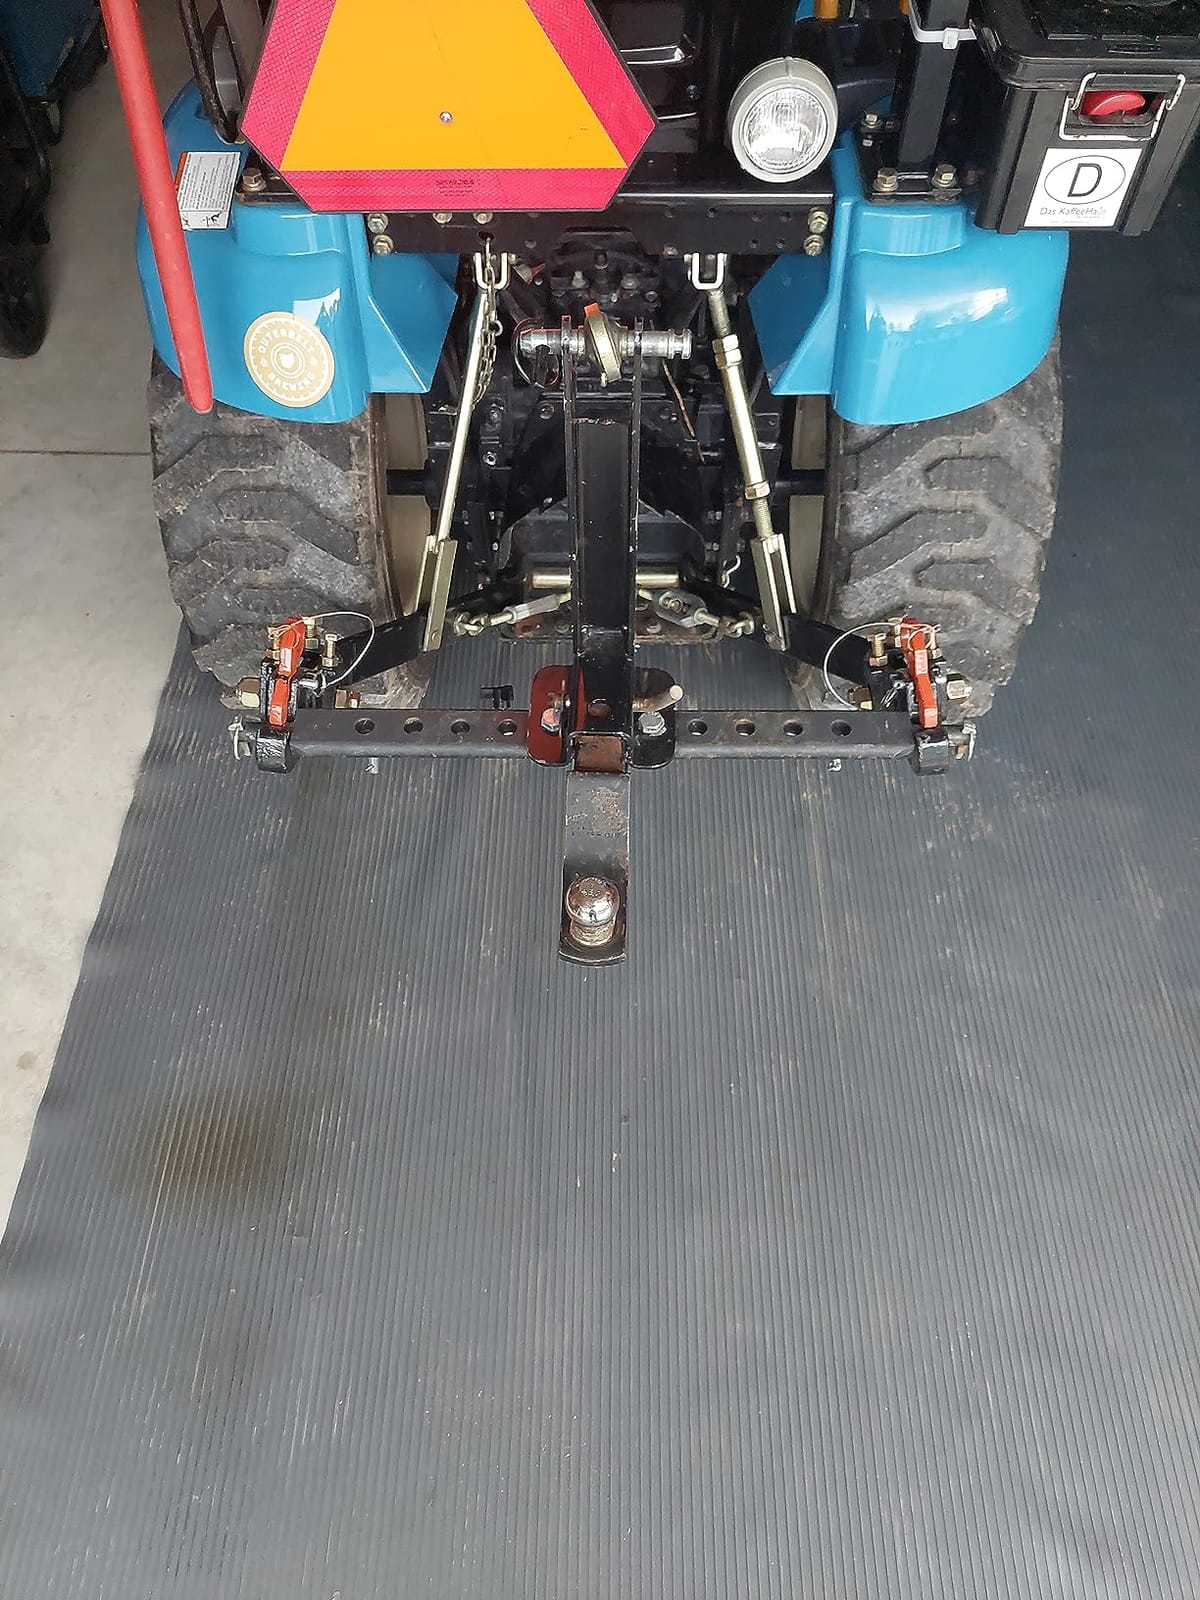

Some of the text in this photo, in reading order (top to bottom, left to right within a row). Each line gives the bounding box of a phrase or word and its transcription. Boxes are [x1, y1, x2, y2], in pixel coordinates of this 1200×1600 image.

[1067, 163, 1102, 197] D
[1040, 206, 1057, 216] Das
[268, 371, 316, 392] BREWING
